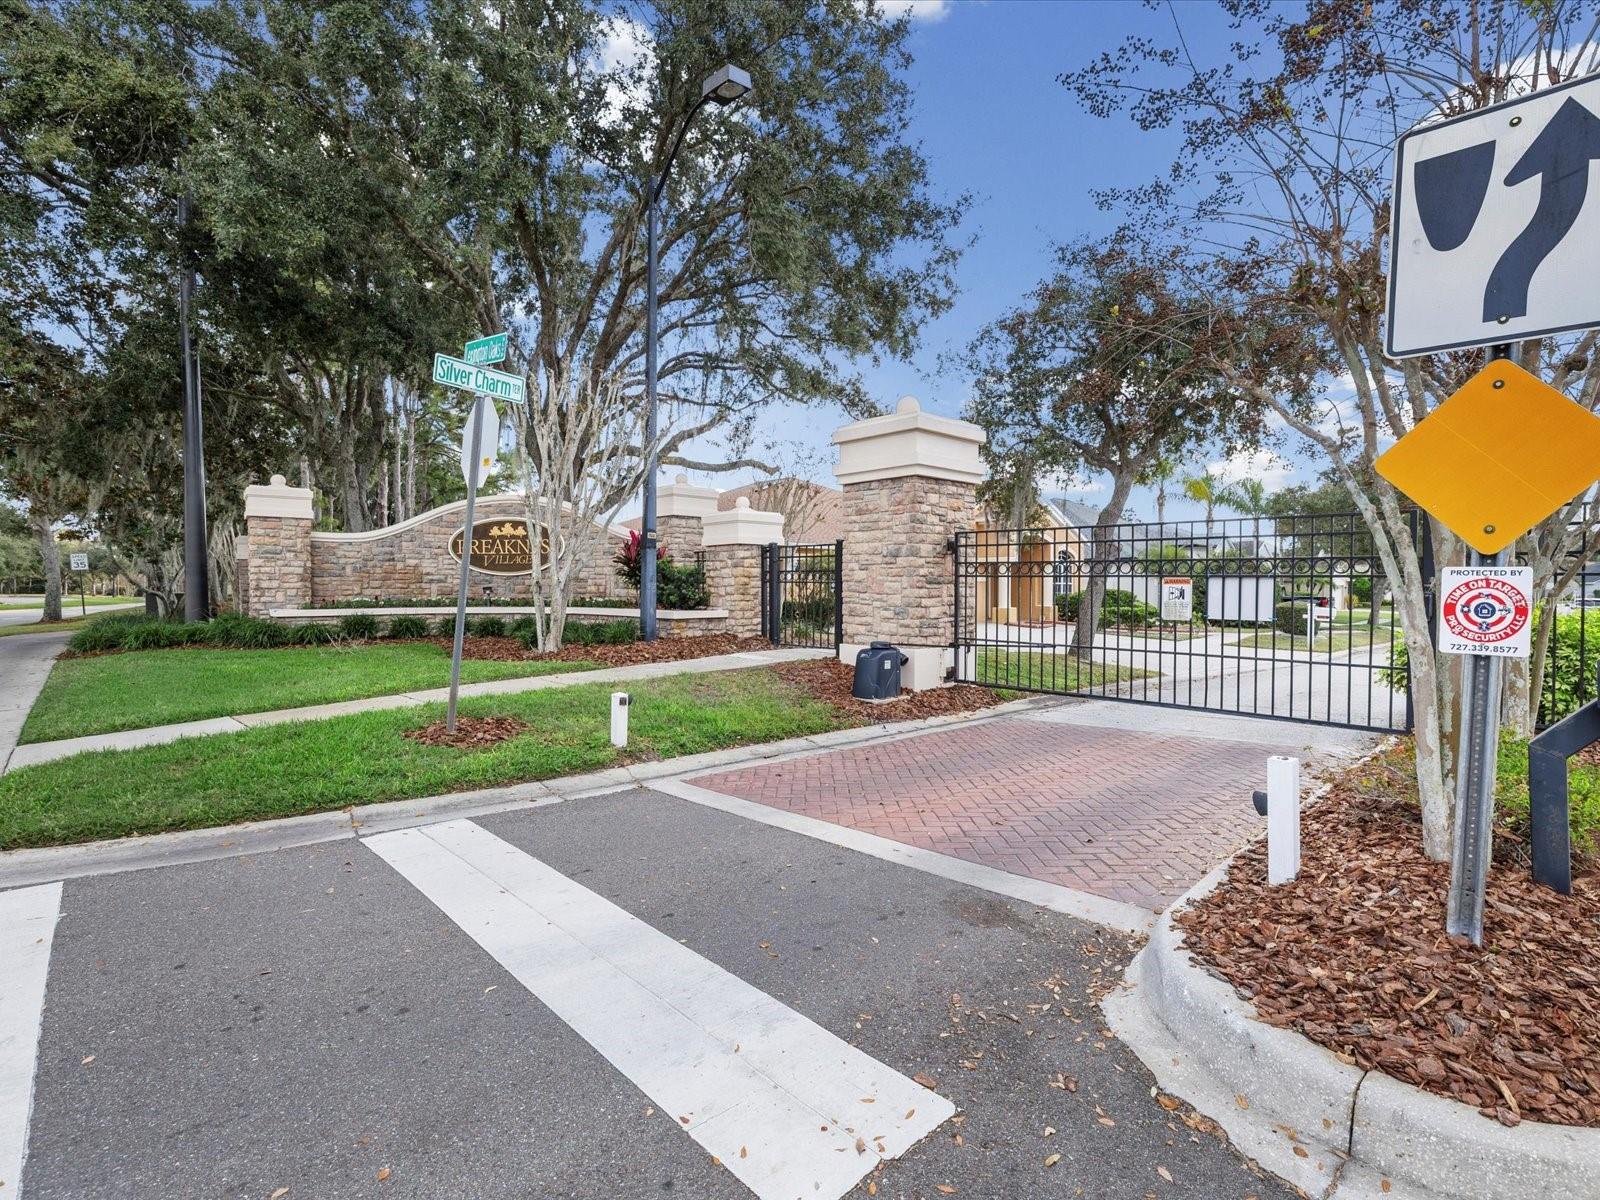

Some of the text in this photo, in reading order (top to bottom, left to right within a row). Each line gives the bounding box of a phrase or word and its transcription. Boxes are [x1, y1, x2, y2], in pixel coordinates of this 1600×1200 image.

[438, 359, 521, 397] Silver Charm TER
[456, 538, 552, 555] REAKNS
[1446, 580, 1527, 608] TIME ON TARGET
[1462, 626, 1514, 641] SECURITY
[1511, 614, 1526, 631] LLC
[1450, 644, 1518, 654] 727.339.8577
